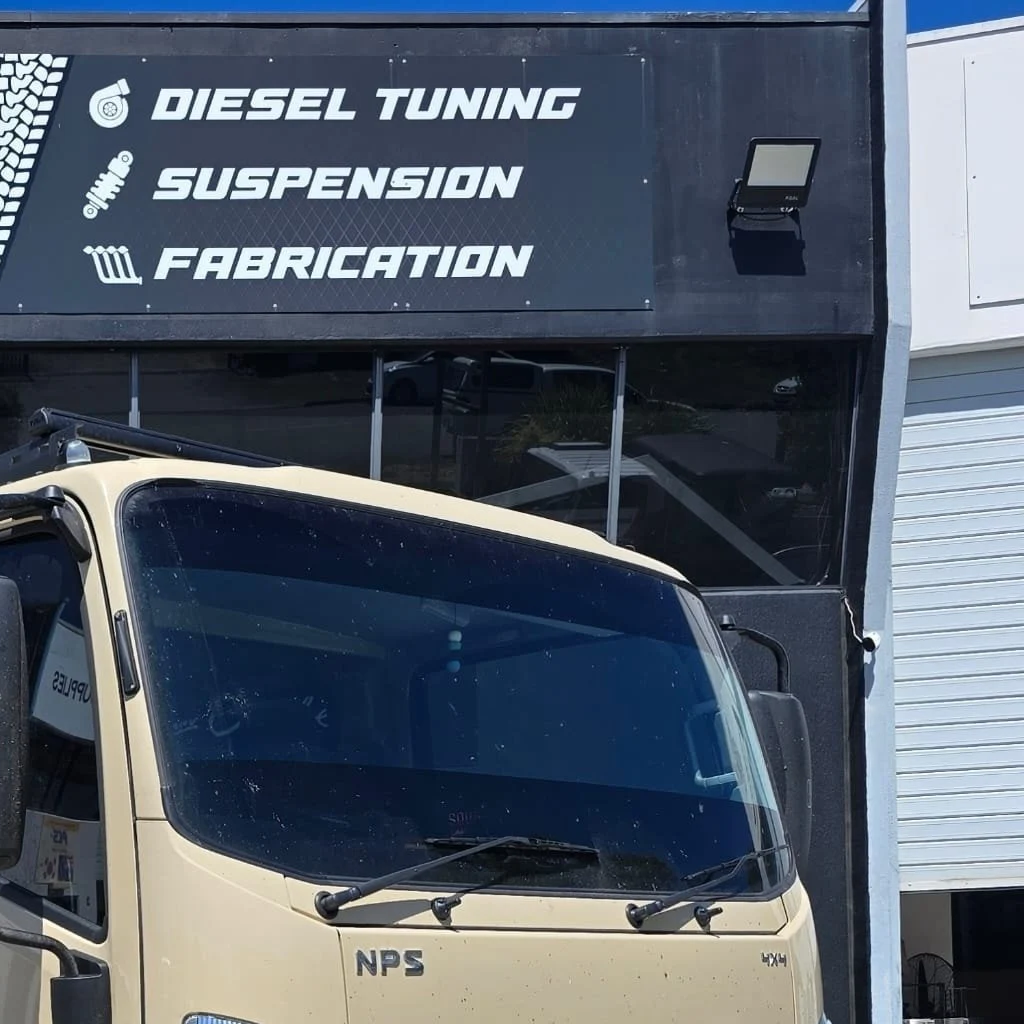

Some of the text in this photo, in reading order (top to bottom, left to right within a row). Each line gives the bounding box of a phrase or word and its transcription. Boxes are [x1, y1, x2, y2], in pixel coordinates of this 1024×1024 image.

[151, 87, 581, 120] DIESEL TUNING
[152, 166, 524, 200] SUSPENSION
[153, 245, 534, 280] FABRICATION
[356, 949, 425, 977] NPS
